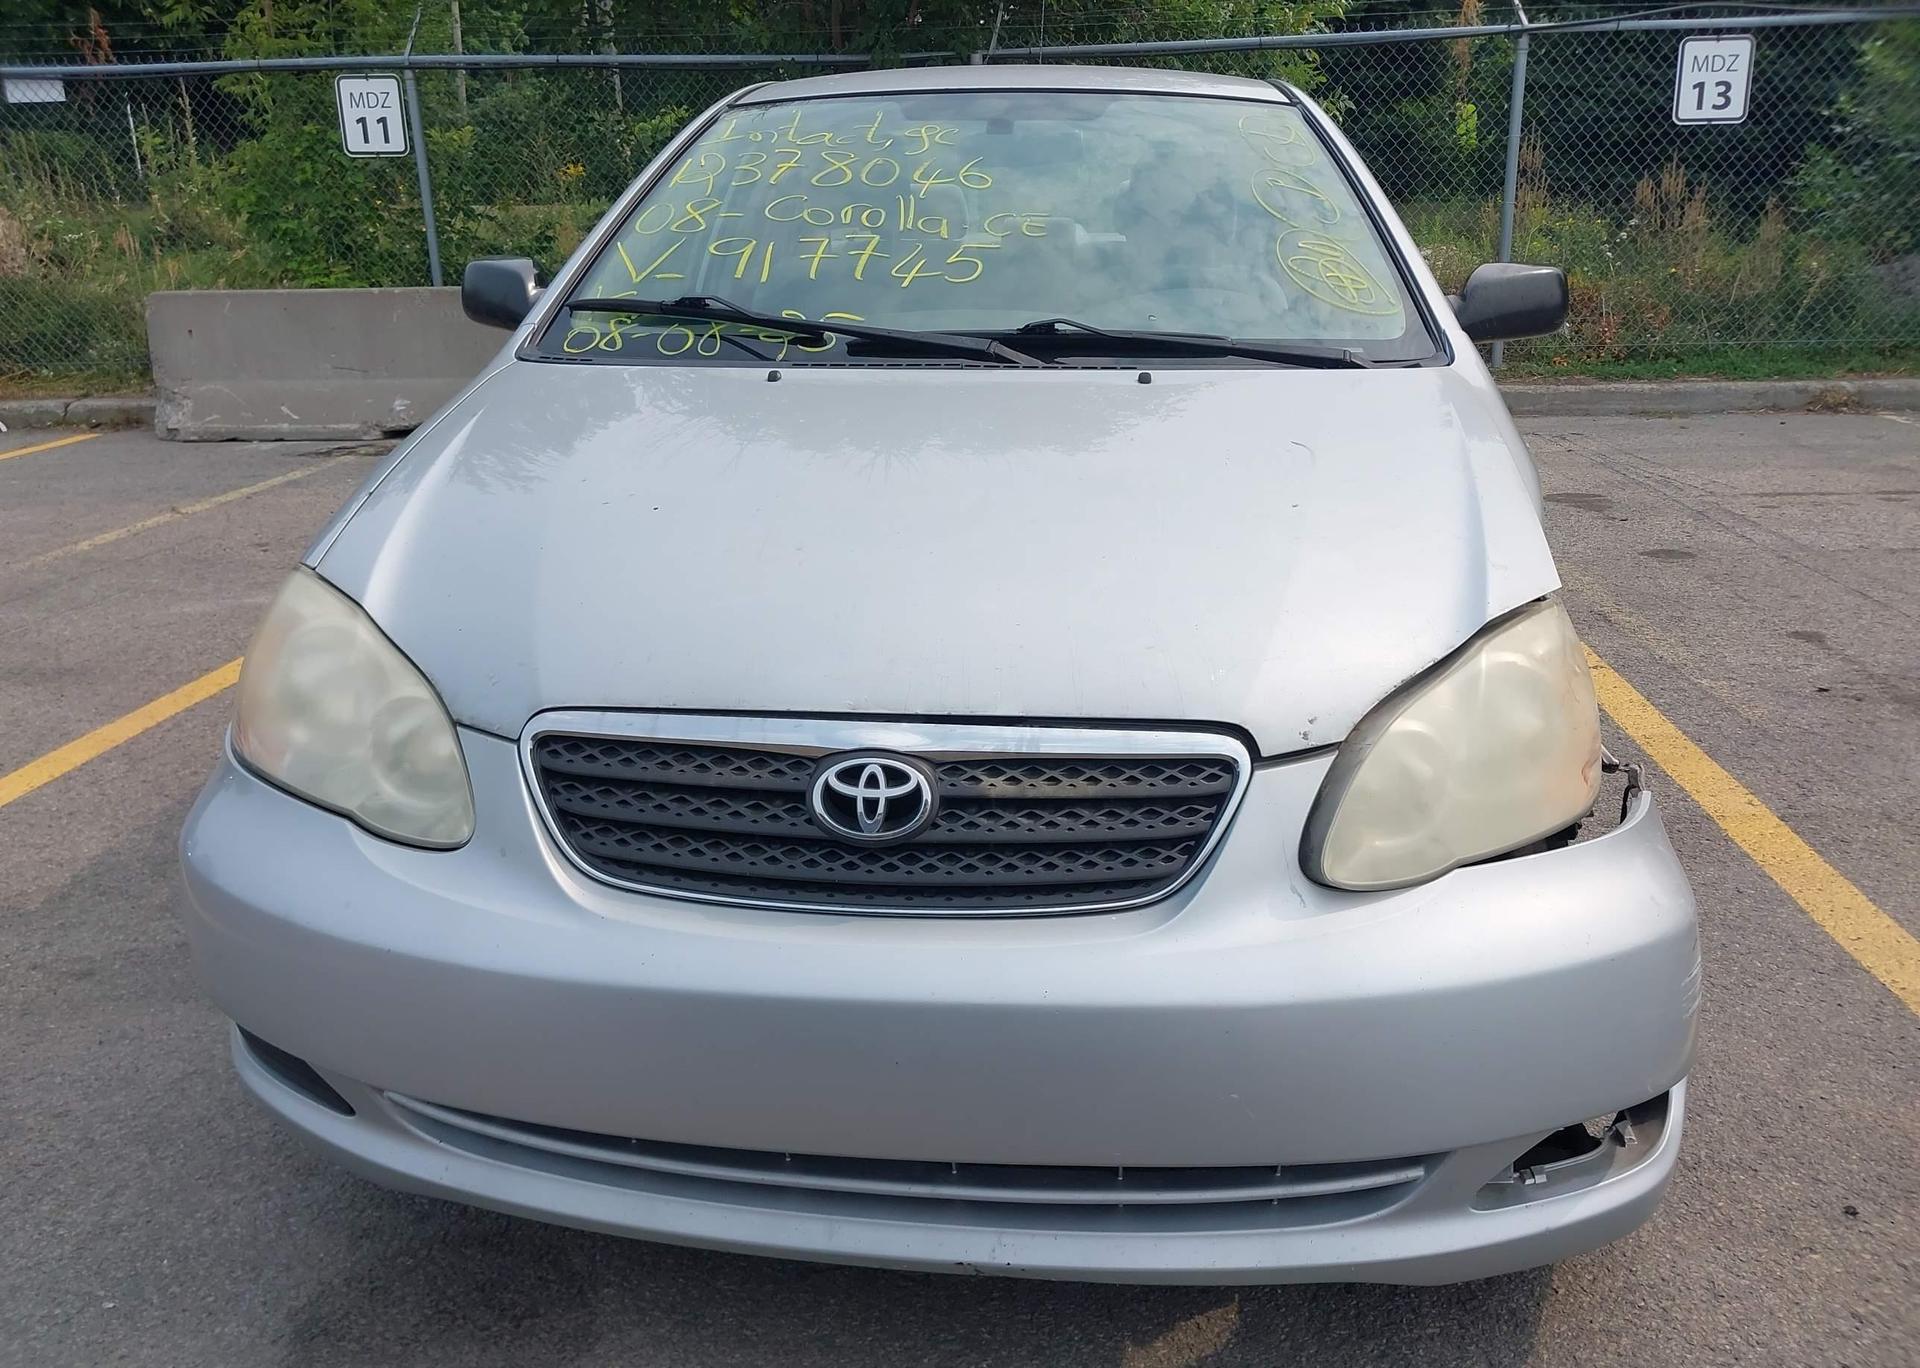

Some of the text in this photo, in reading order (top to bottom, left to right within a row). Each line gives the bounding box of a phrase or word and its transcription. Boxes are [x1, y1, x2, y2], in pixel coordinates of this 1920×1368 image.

[1690, 54, 1740, 73] MDZ
[349, 91, 392, 109] MDZ
[1692, 80, 1732, 110] 13
[355, 116, 390, 144] 11
[764, 194, 949, 239] Corolla
[984, 213, 1050, 238] CE
[708, 234, 1001, 288] 917745
